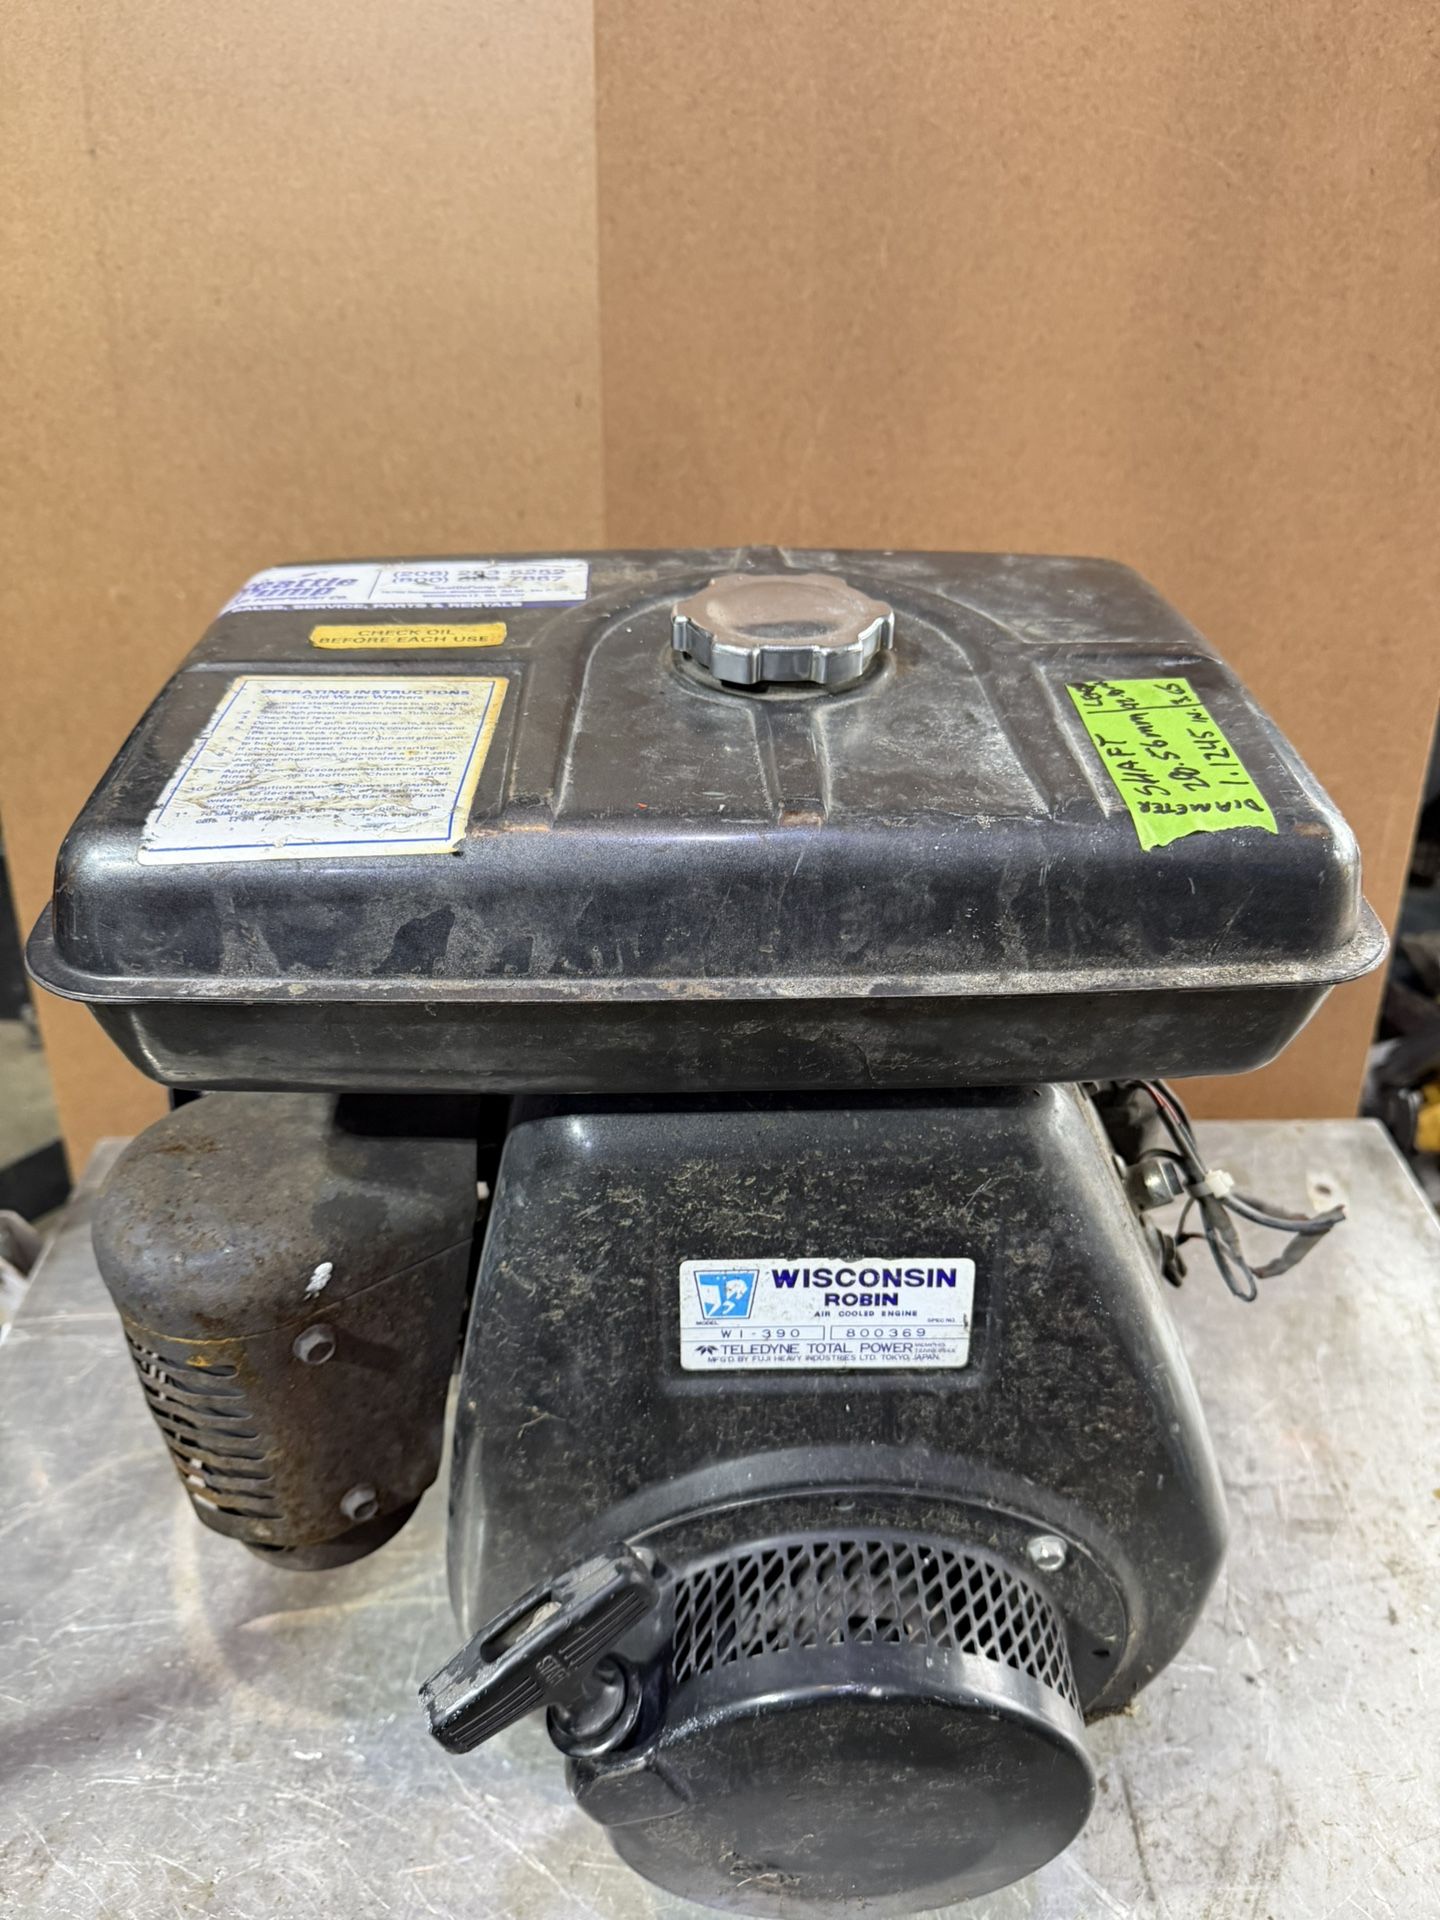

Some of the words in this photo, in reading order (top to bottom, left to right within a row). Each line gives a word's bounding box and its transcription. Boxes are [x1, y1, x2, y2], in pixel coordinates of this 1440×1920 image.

[319, 636, 390, 644] BEFORE
[1186, 727, 1250, 785] 1.1245
[1095, 733, 1171, 796] SHAFT
[1137, 798, 1265, 815] DIAMETER
[771, 1267, 957, 1289] WISCONSIN
[824, 1292, 899, 1307] ROBIN
[846, 1328, 927, 1338] 800369
[720, 1343, 801, 1355] TELEDYNE
[807, 1342, 853, 1354] TOTAL
[860, 1342, 914, 1354] POWER
[805, 1354, 857, 1362] INDUSTRIES
